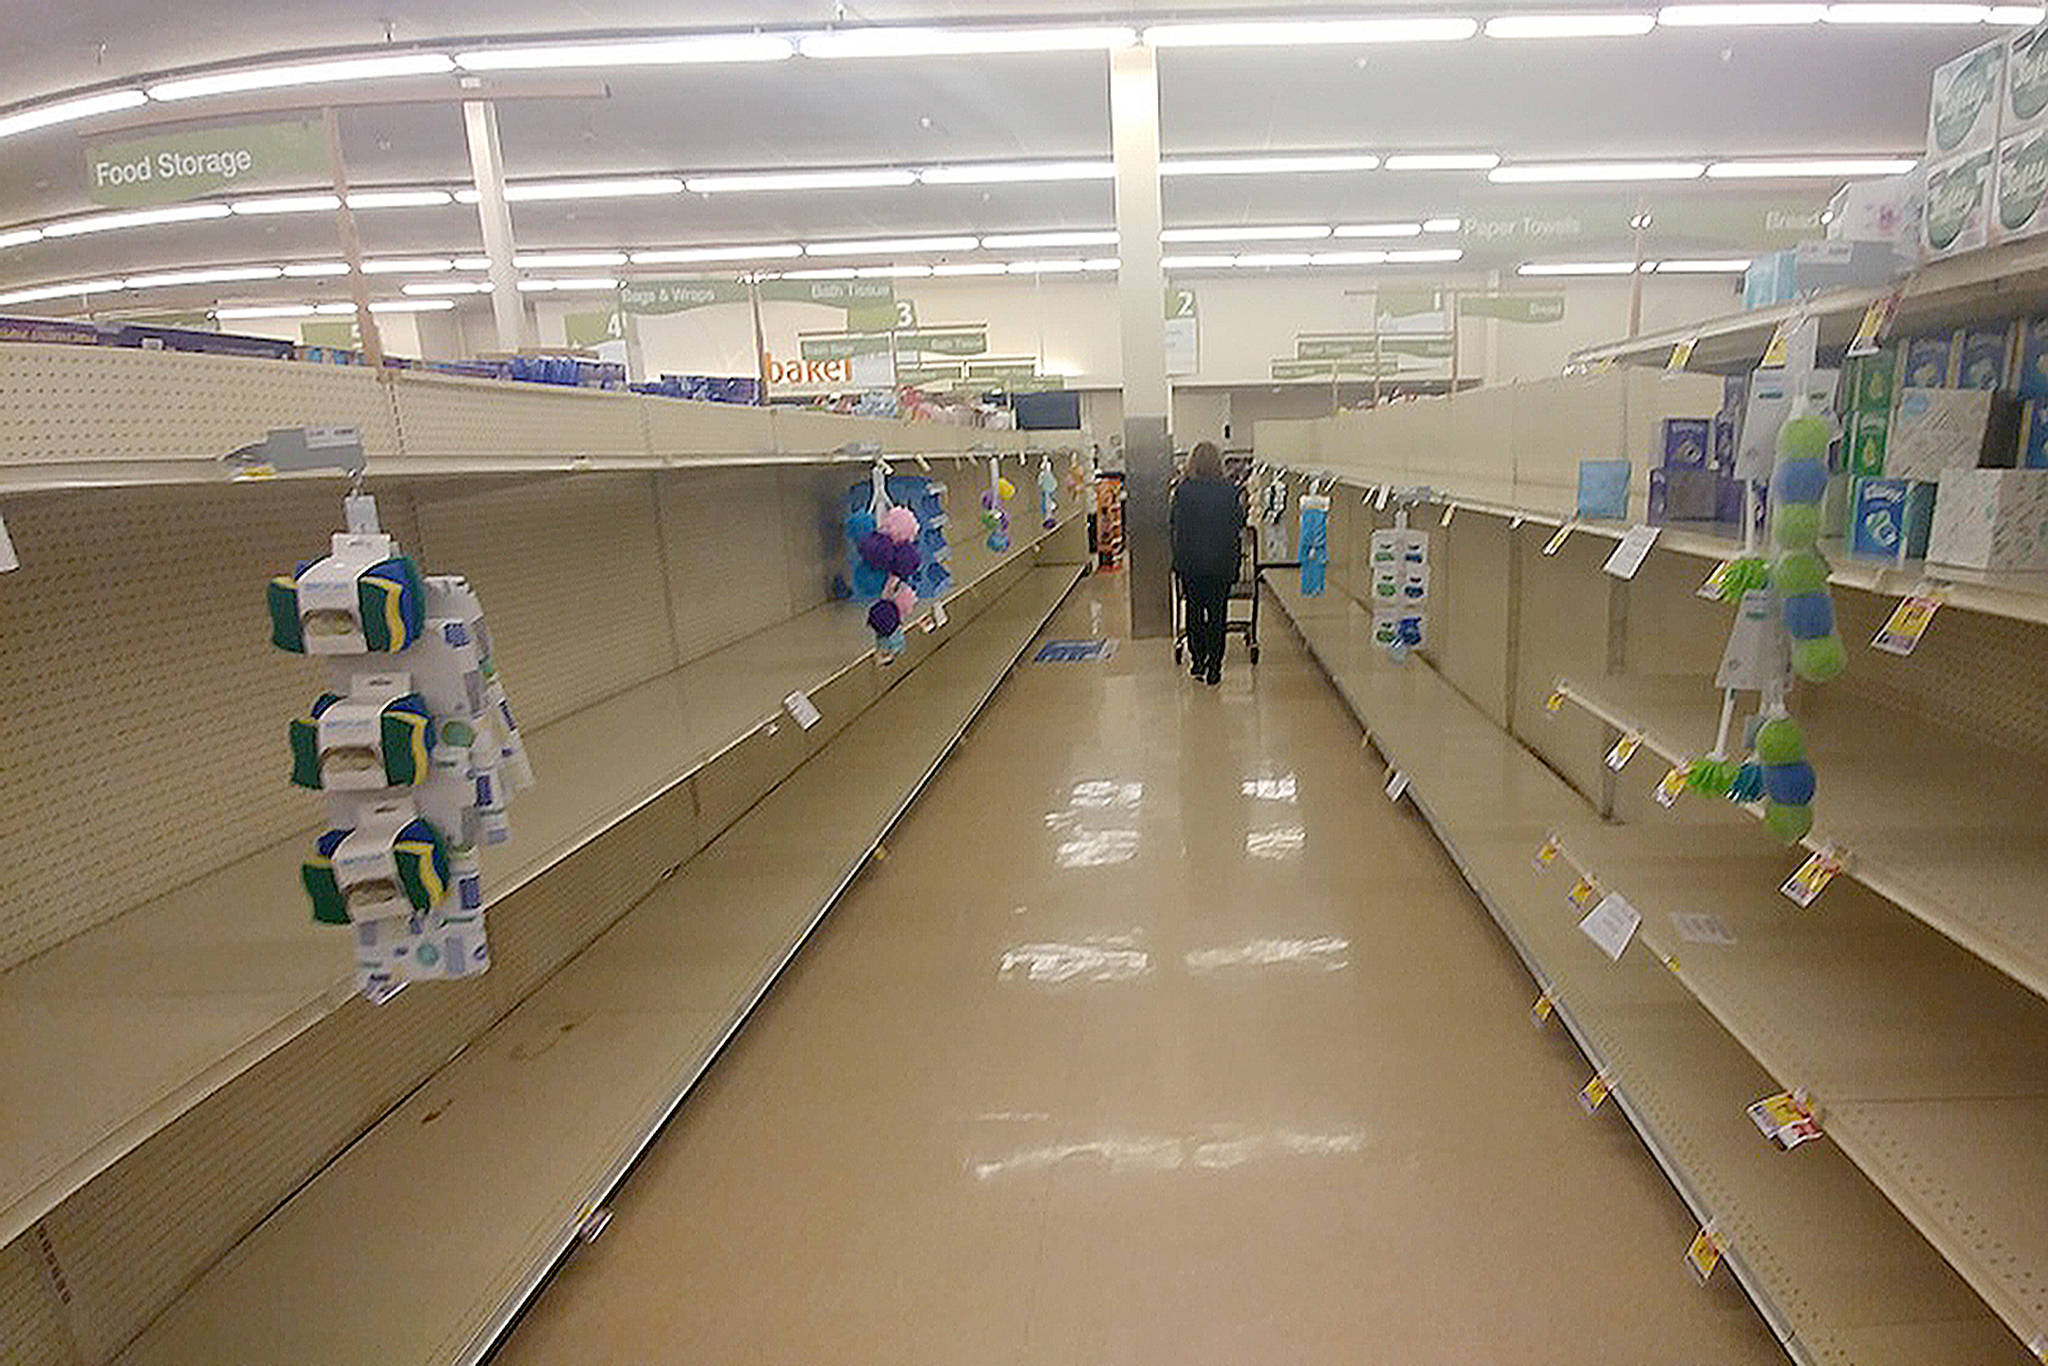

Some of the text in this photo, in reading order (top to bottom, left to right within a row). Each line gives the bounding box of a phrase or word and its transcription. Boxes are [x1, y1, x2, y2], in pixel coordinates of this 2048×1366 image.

[95, 149, 252, 186] Food Storage
[1464, 218, 1517, 240] Paper
[621, 287, 656, 305] Bags
[658, 288, 670, 301] &
[1177, 291, 1194, 316] 2
[607, 312, 622, 338] 4
[897, 302, 913, 327] 3
